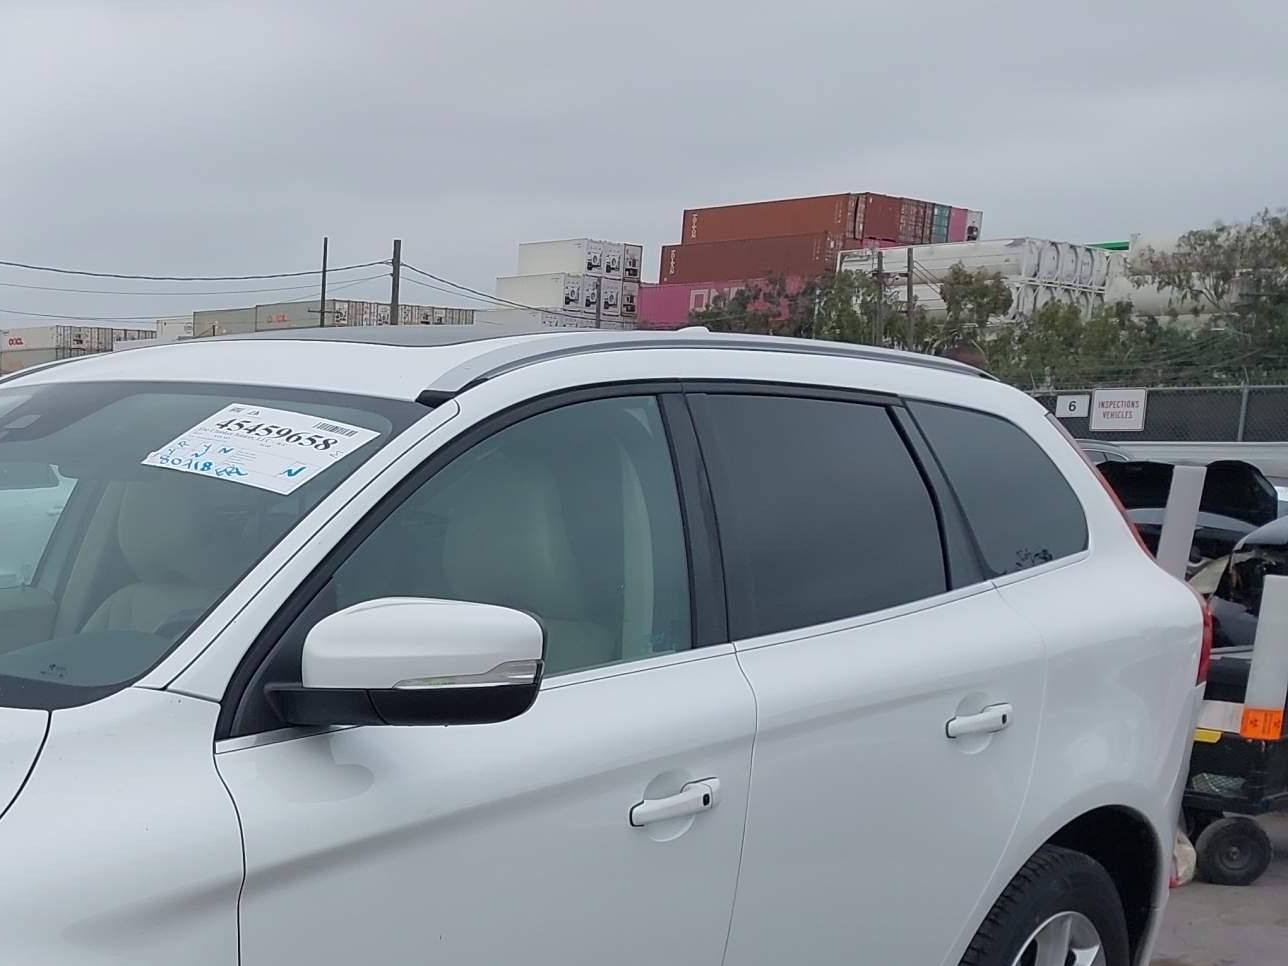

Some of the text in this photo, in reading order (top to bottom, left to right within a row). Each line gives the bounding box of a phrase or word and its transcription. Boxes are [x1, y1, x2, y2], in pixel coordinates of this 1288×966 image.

[1068, 400, 1077, 412] 6
[1097, 400, 1140, 409] INSPECTIONS
[1102, 410, 1133, 419] VEHICLES
[216, 417, 339, 451] 45459658
